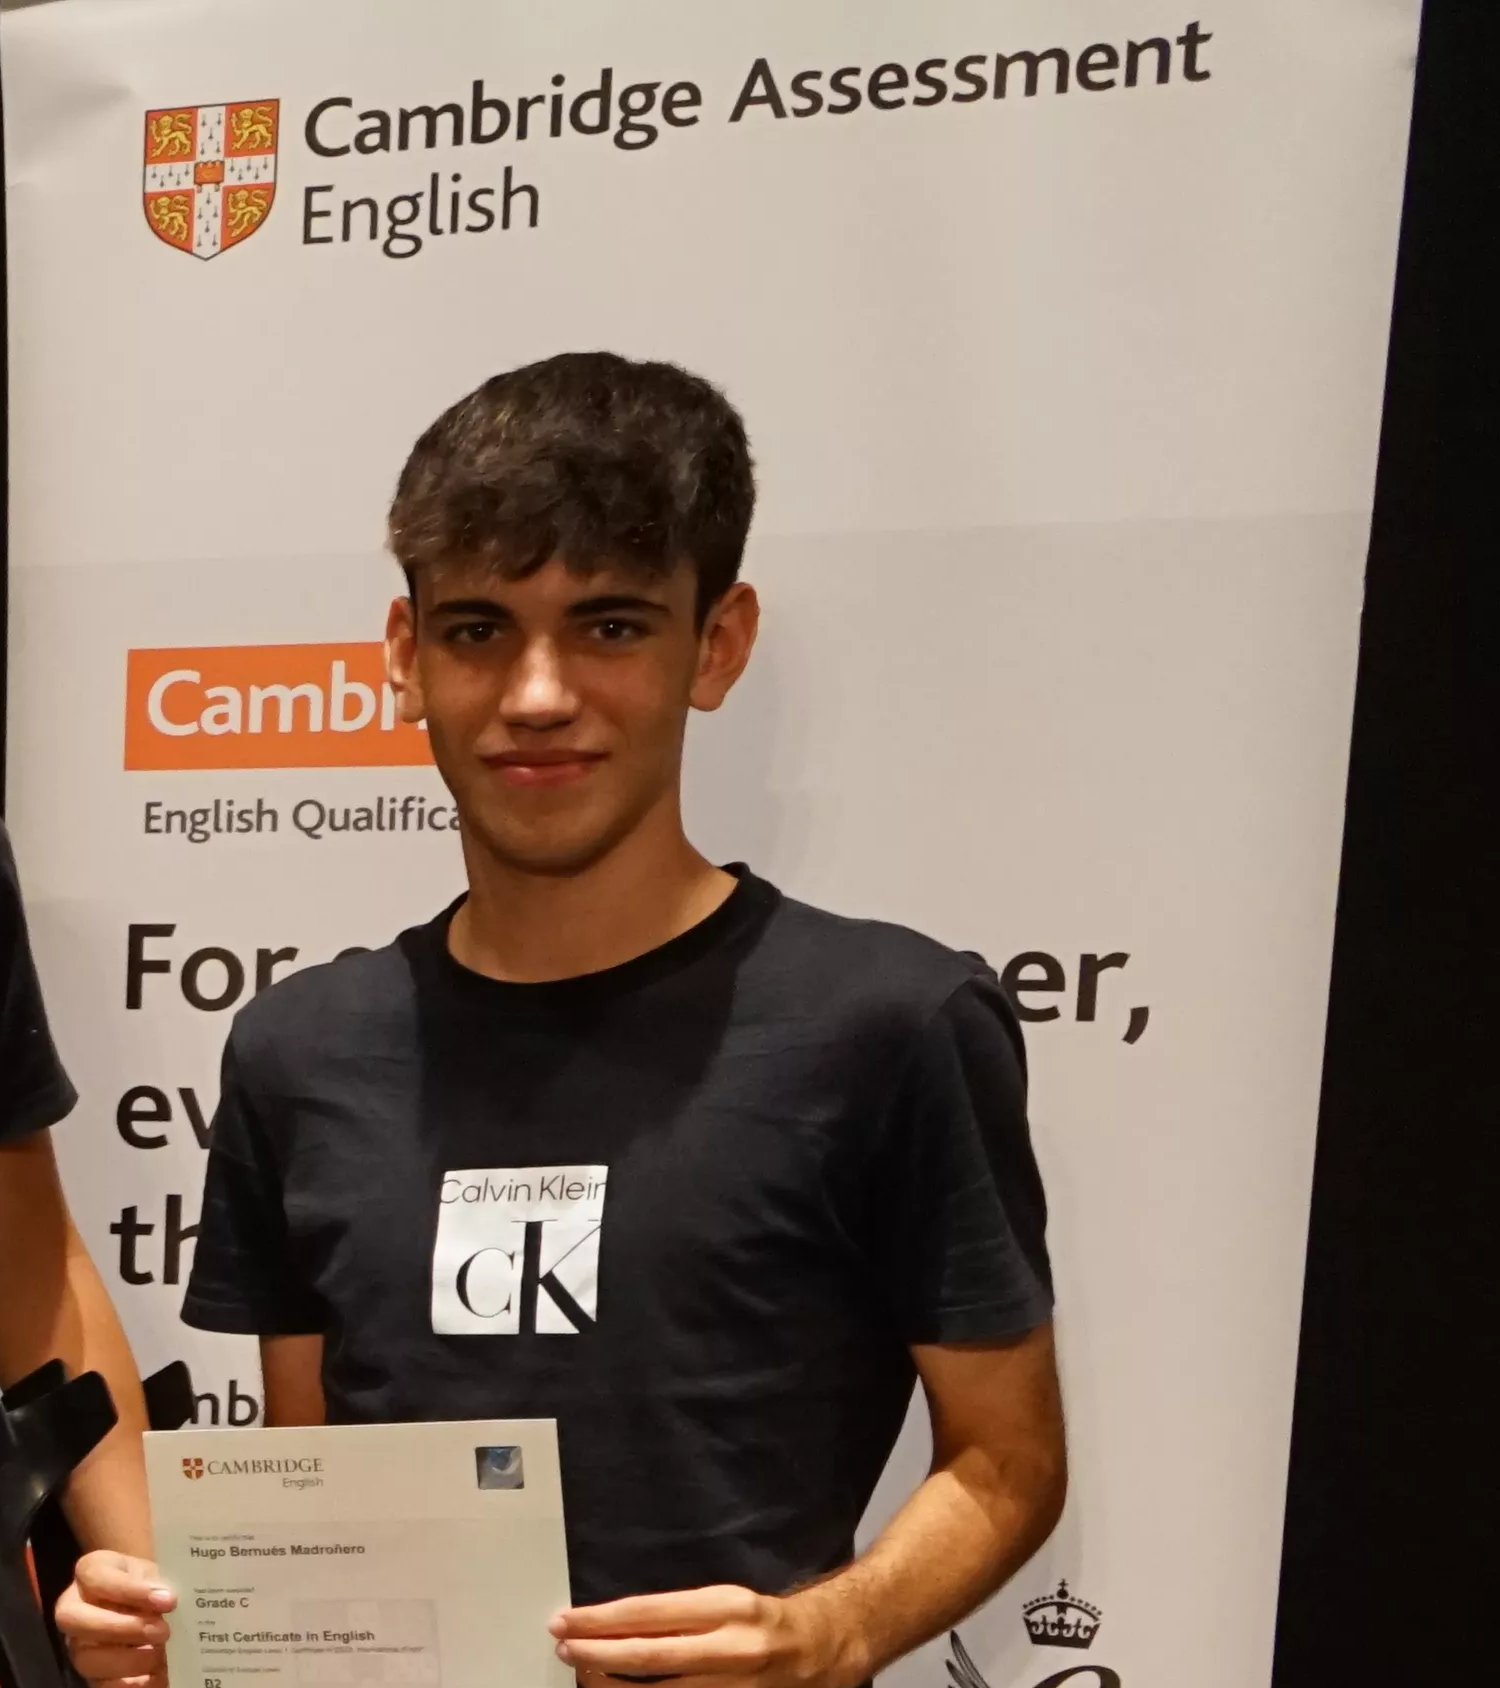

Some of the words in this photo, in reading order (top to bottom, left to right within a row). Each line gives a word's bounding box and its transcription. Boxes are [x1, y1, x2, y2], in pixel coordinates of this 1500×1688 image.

[304, 67, 703, 158] Cambridge
[727, 19, 1214, 124] Assessment
[302, 165, 540, 260] English
[147, 659, 412, 737] Cambr
[143, 797, 279, 844] English
[124, 923, 301, 1012] For
[439, 1176, 532, 1205] Calvin
[455, 1218, 603, 1335] CK
[207, 1457, 325, 1476] CAMBRIDGE
[281, 1476, 324, 1490] English
[189, 1546, 226, 1560] Hugo
[194, 1597, 236, 1609] Grade
[239, 1597, 250, 1608] C
[198, 1631, 230, 1643] First
[232, 1631, 302, 1643] Certificate
[305, 1630, 319, 1642] in
[322, 1629, 376, 1645] English
